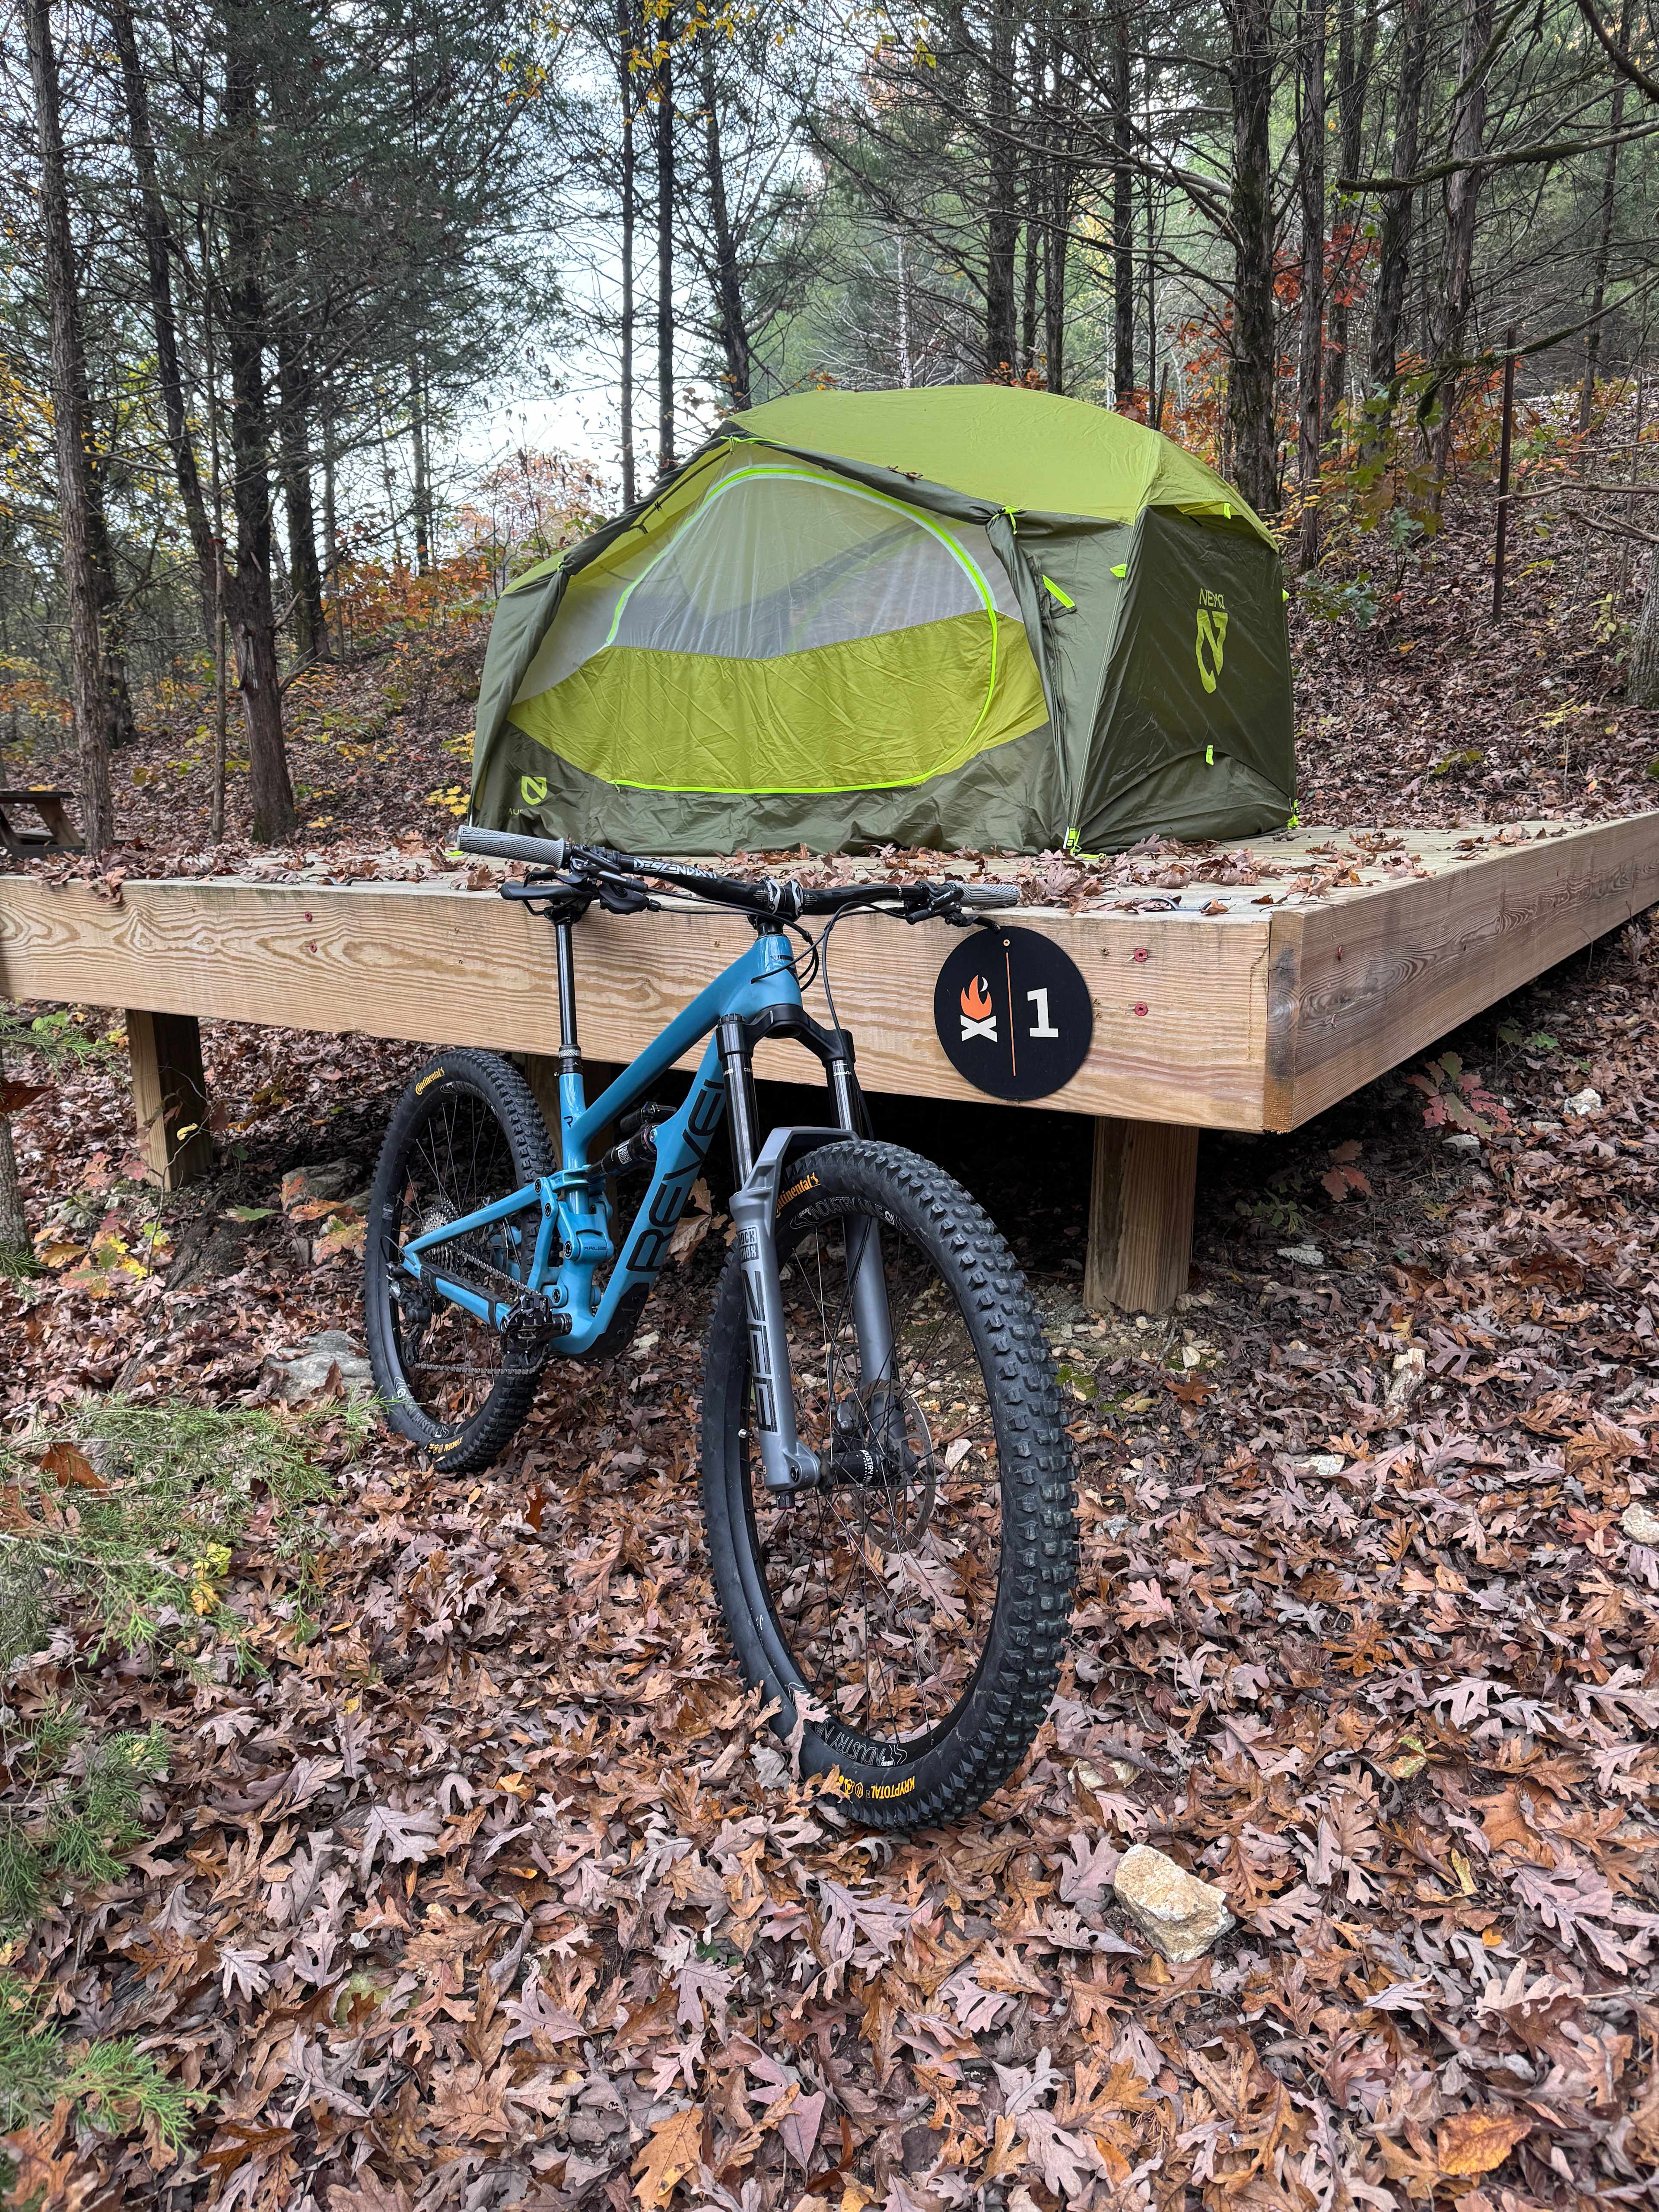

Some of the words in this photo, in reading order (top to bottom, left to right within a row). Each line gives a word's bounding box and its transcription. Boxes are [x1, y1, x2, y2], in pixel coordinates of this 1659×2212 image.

[1027, 987, 1059, 1038] 1
[415, 1068, 442, 1095] Continental
[776, 1175, 813, 1218] ntinental
[871, 1776, 915, 1799] KRYPTOTAL
